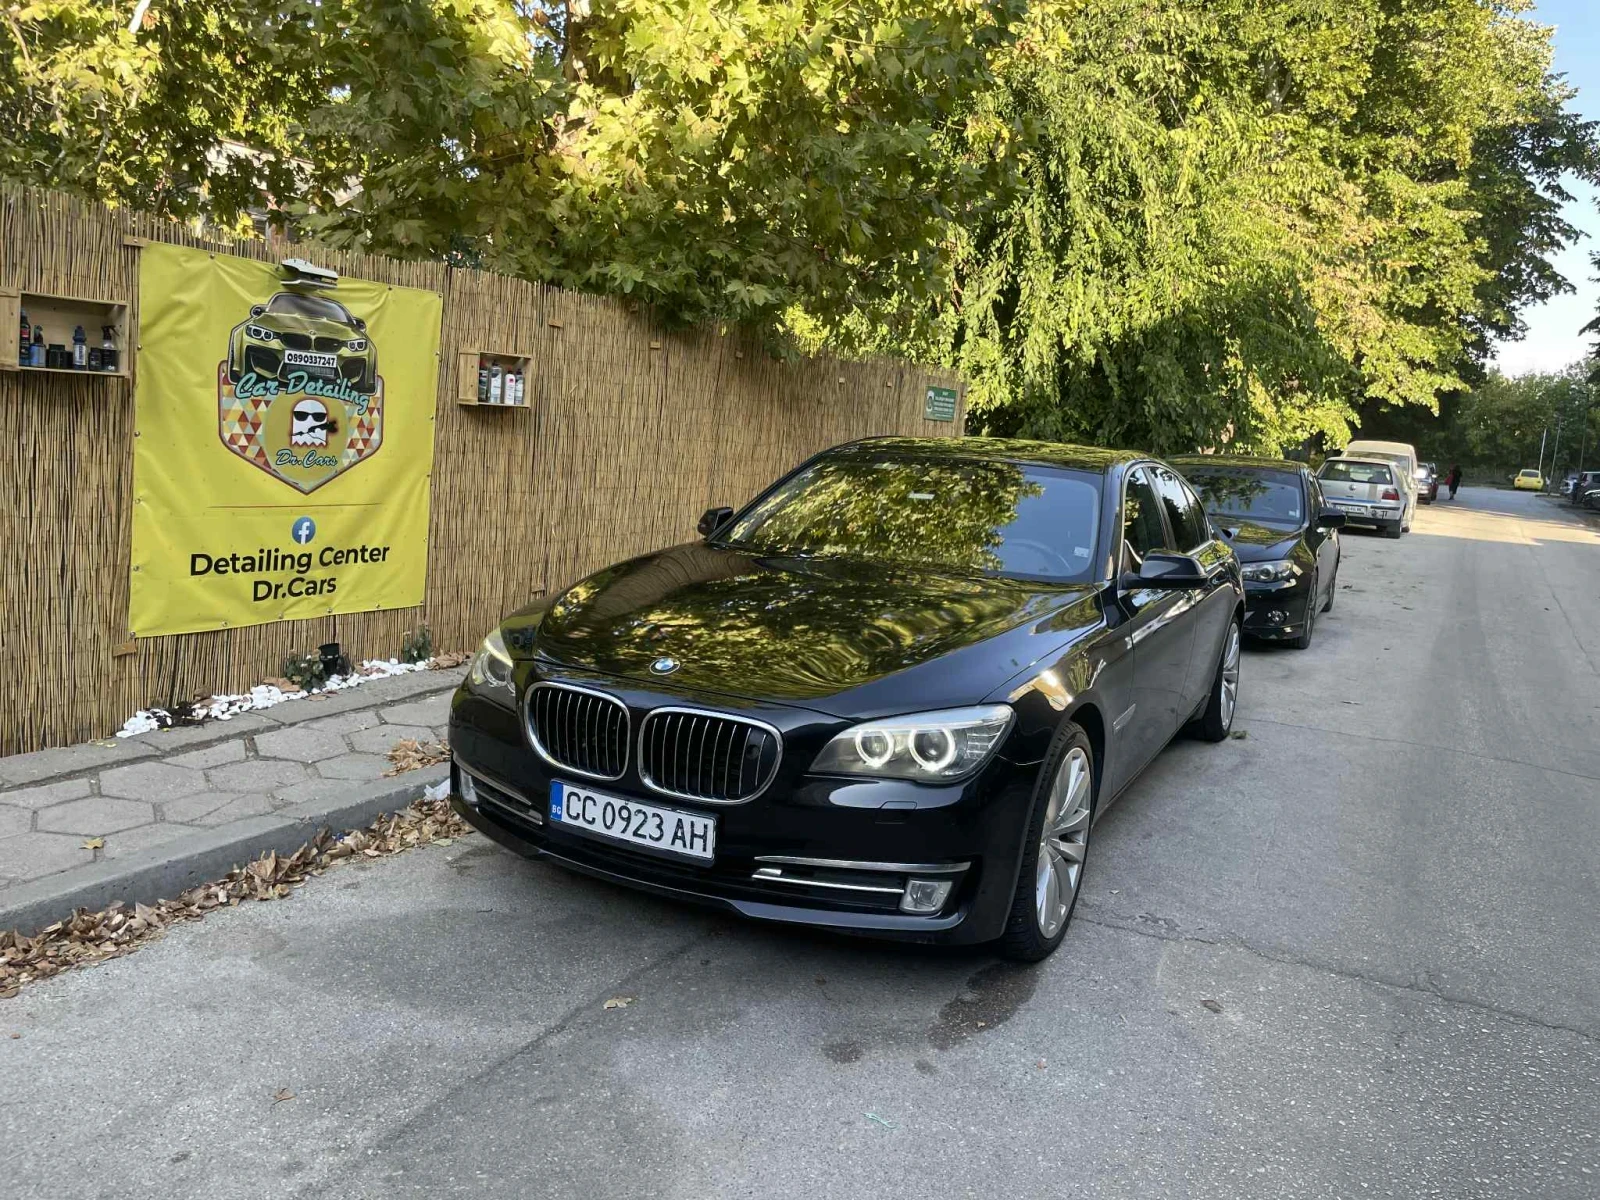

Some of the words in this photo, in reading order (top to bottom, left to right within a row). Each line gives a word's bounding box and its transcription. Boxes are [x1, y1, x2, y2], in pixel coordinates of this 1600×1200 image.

[287, 353, 336, 367] 0890337247
[234, 372, 279, 399] Car
[286, 371, 370, 415] Detailing
[190, 548, 312, 575] Detailing
[319, 545, 390, 567] Center
[253, 577, 337, 602] Dr.Cars
[551, 806, 562, 815] BG
[566, 791, 597, 825] CC
[602, 801, 664, 842] 0923
[670, 818, 708, 852] AH
